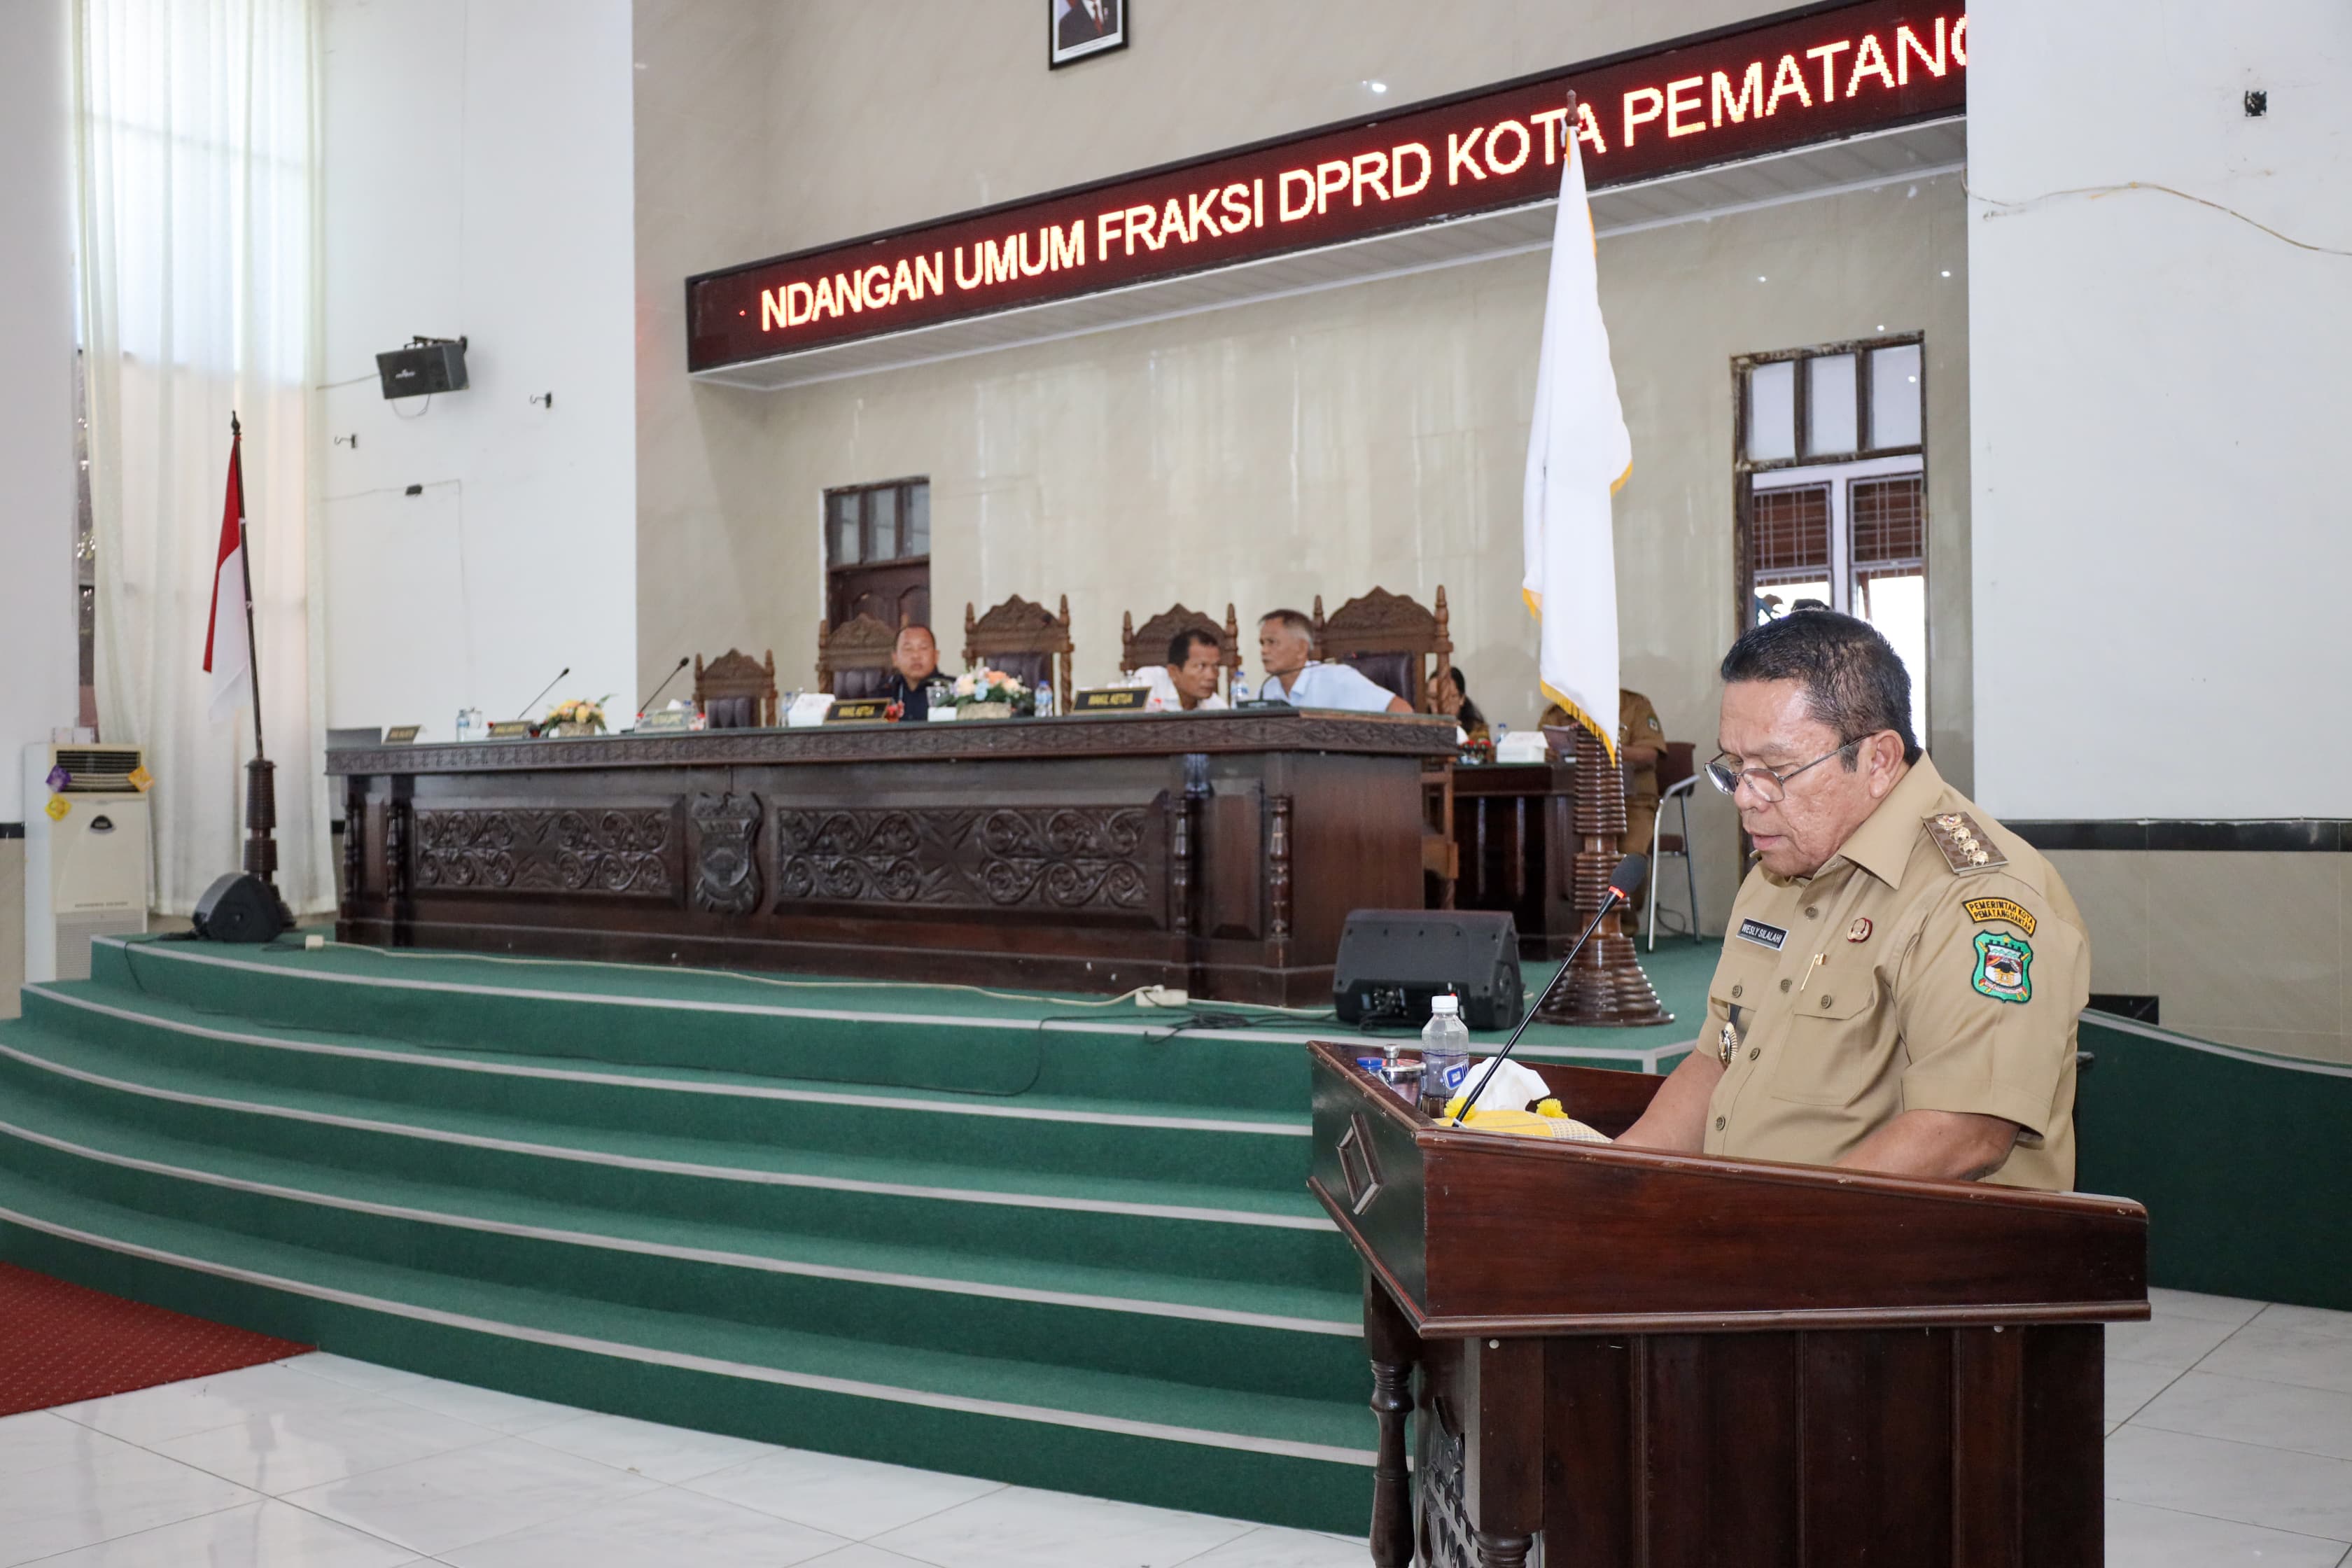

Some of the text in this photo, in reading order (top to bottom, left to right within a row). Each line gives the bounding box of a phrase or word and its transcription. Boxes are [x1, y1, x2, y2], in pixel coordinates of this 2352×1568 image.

[762, 251, 944, 331] NDANGAN
[955, 220, 1086, 289] UMUM
[1098, 178, 1264, 261] FRAKSI
[1280, 142, 1432, 222] DPRD
[1448, 103, 1607, 186] KOTA
[1968, 900, 2033, 924] PEMERINTAH KOTA
[1974, 909, 2031, 931] PEMATANGSIANTAR
[1741, 923, 1783, 944] WESLY SILALAHI
